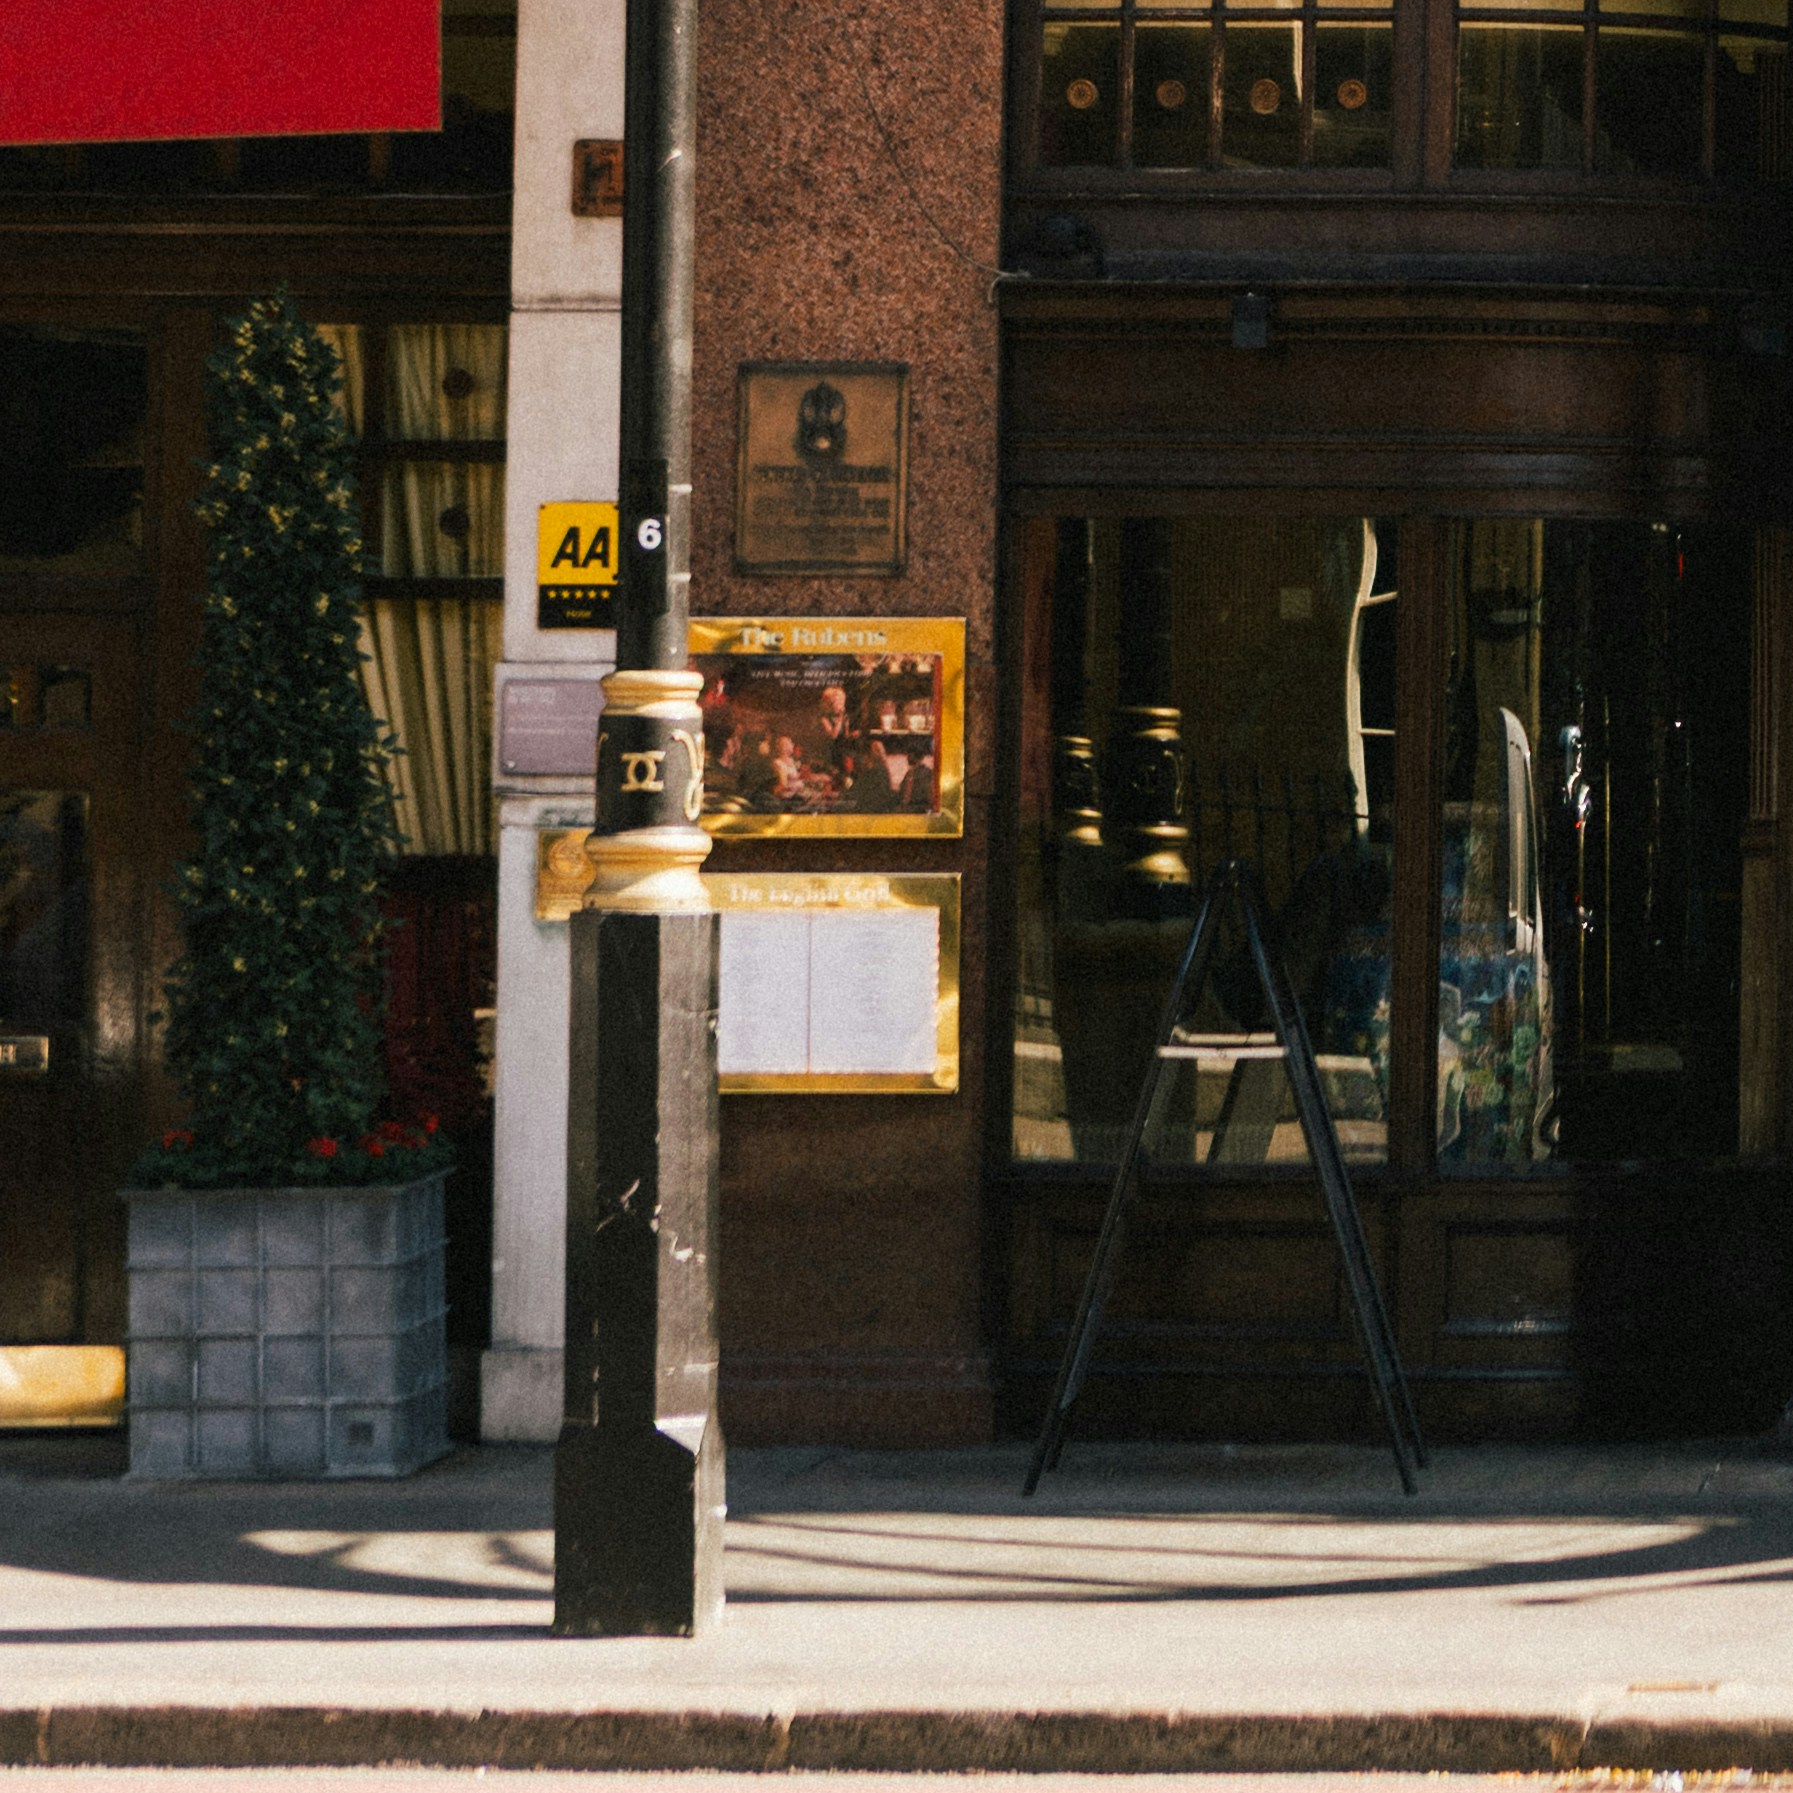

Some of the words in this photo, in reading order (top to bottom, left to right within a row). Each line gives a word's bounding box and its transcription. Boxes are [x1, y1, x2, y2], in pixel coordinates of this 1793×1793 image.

[550, 525, 611, 569] AA
[637, 517, 663, 551] 6
[741, 627, 783, 647] The
[791, 626, 888, 648] Rubens
